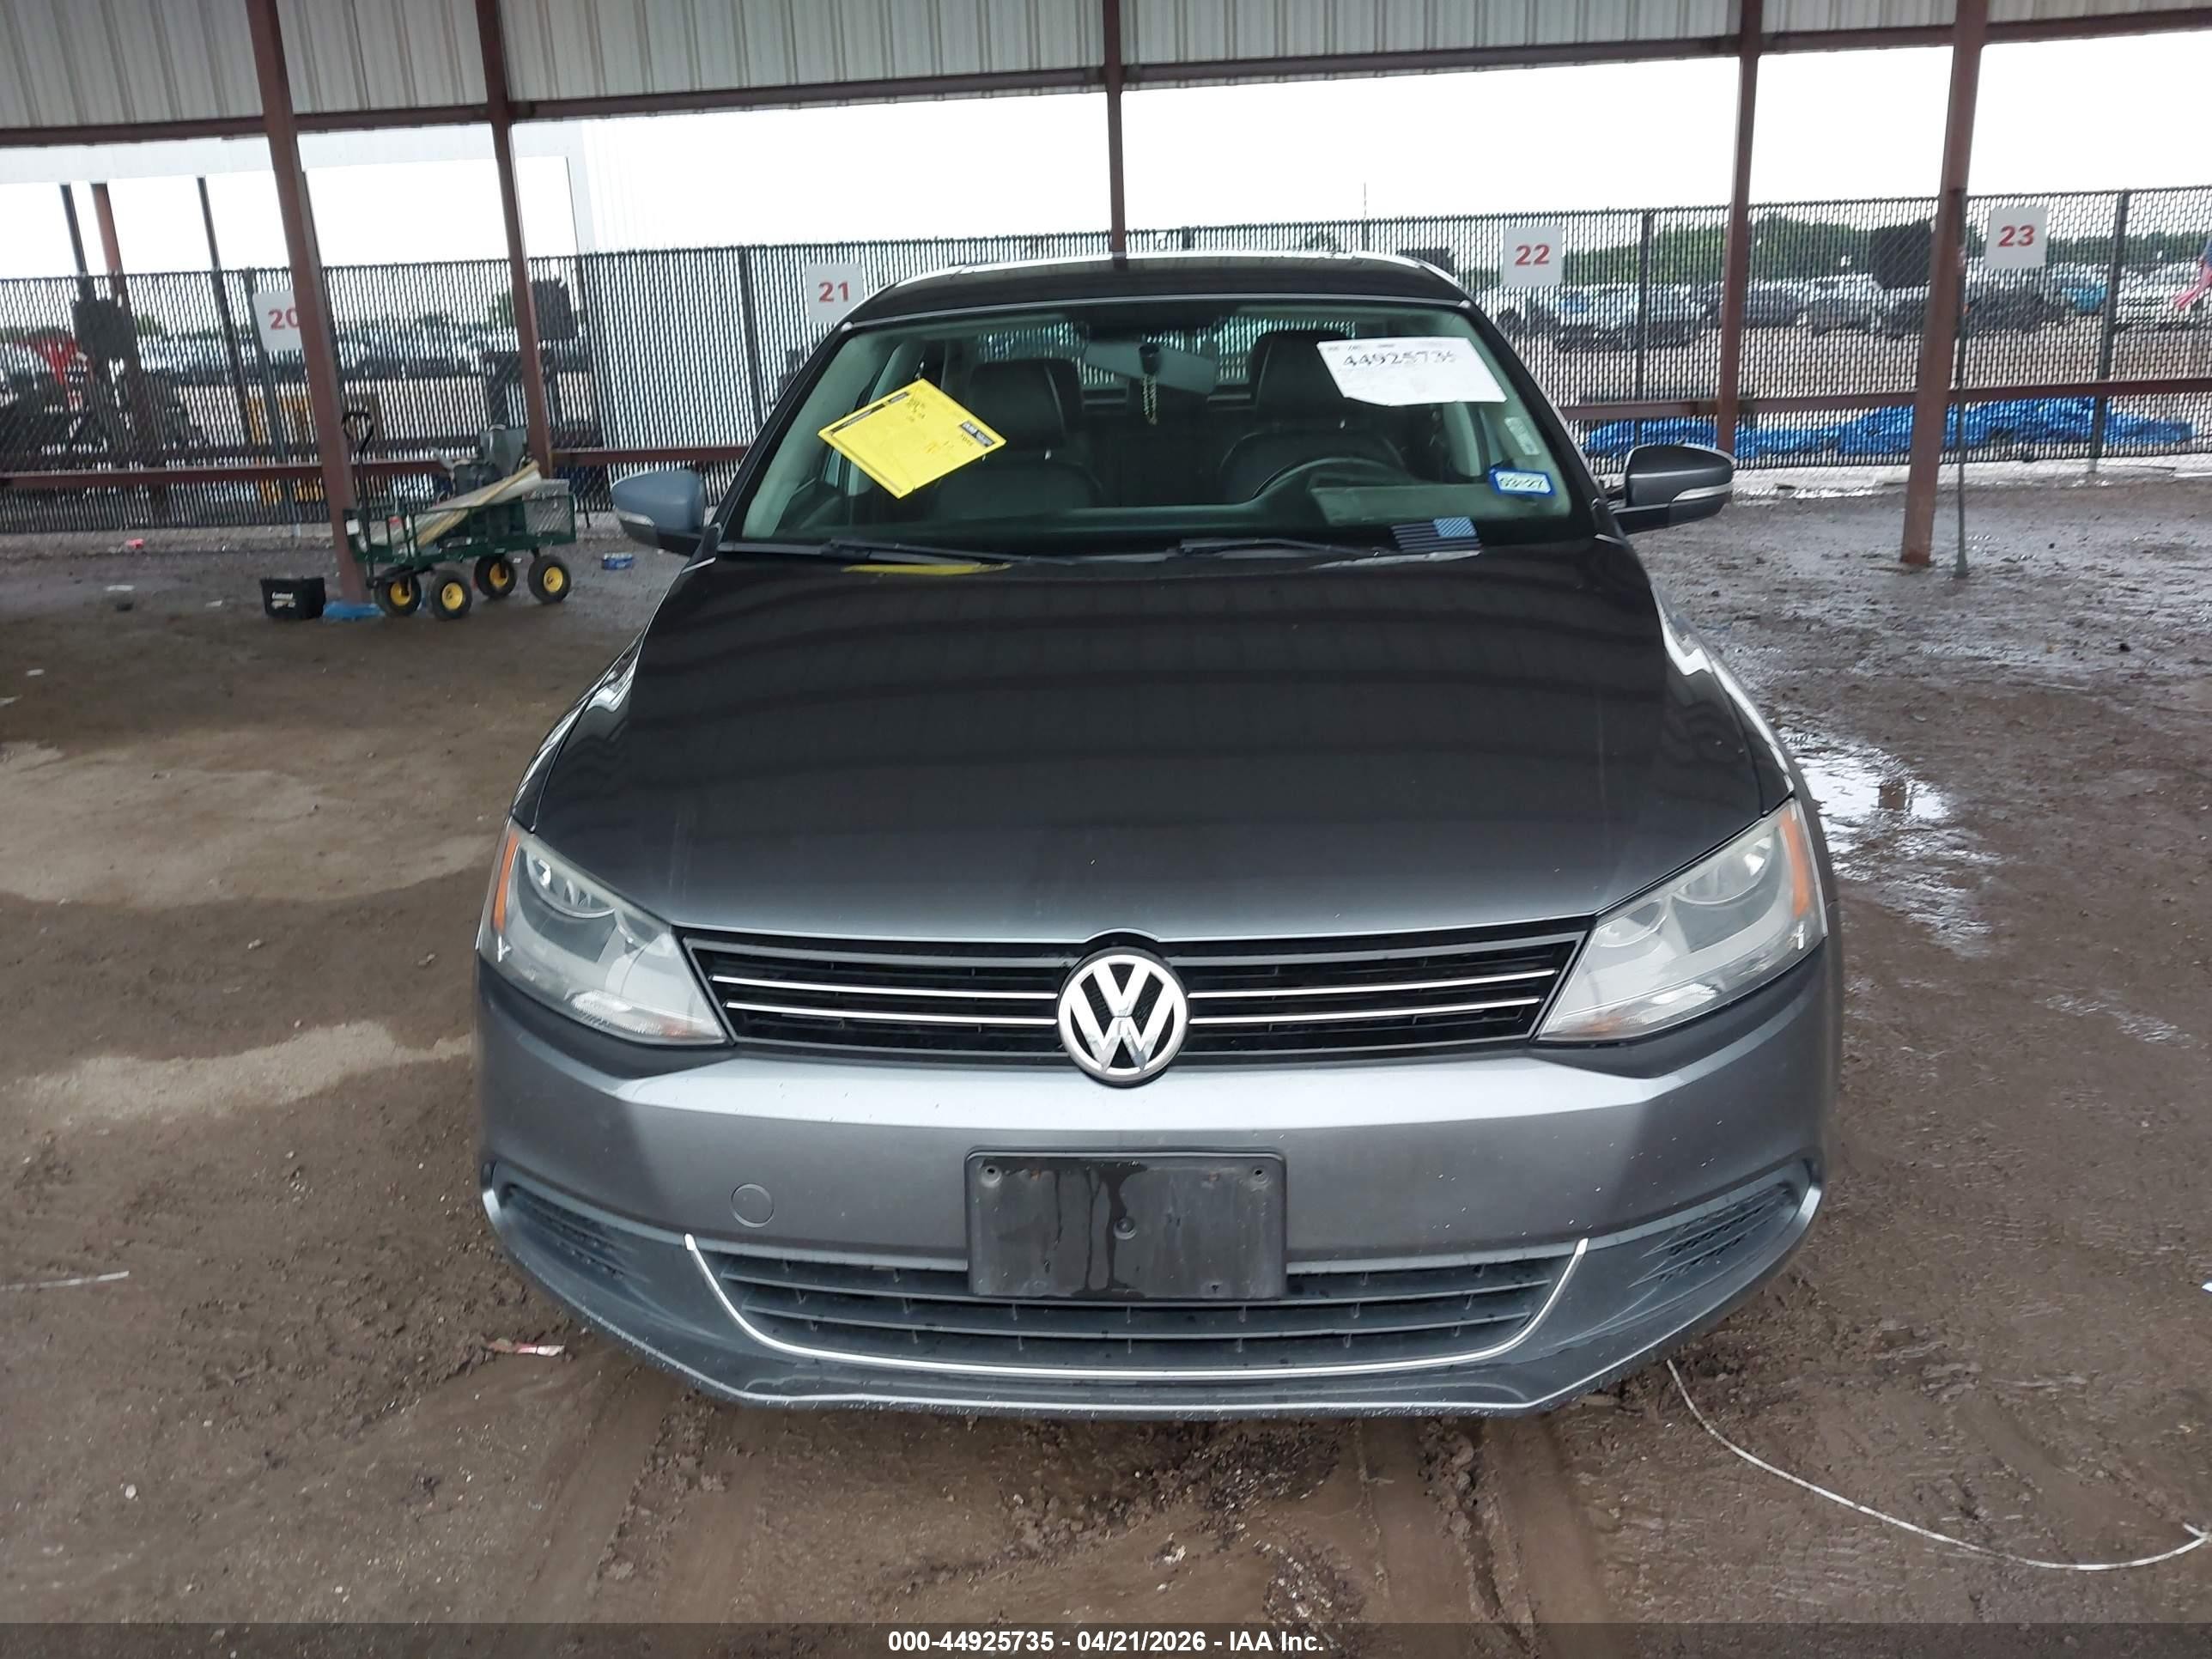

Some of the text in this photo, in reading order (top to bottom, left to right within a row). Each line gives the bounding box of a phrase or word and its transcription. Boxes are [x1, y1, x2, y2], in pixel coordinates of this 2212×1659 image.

[1998, 225, 2034, 247] 23
[1515, 244, 1550, 266] 22
[817, 281, 849, 302] 21
[1060, 955, 1187, 1079] VW
